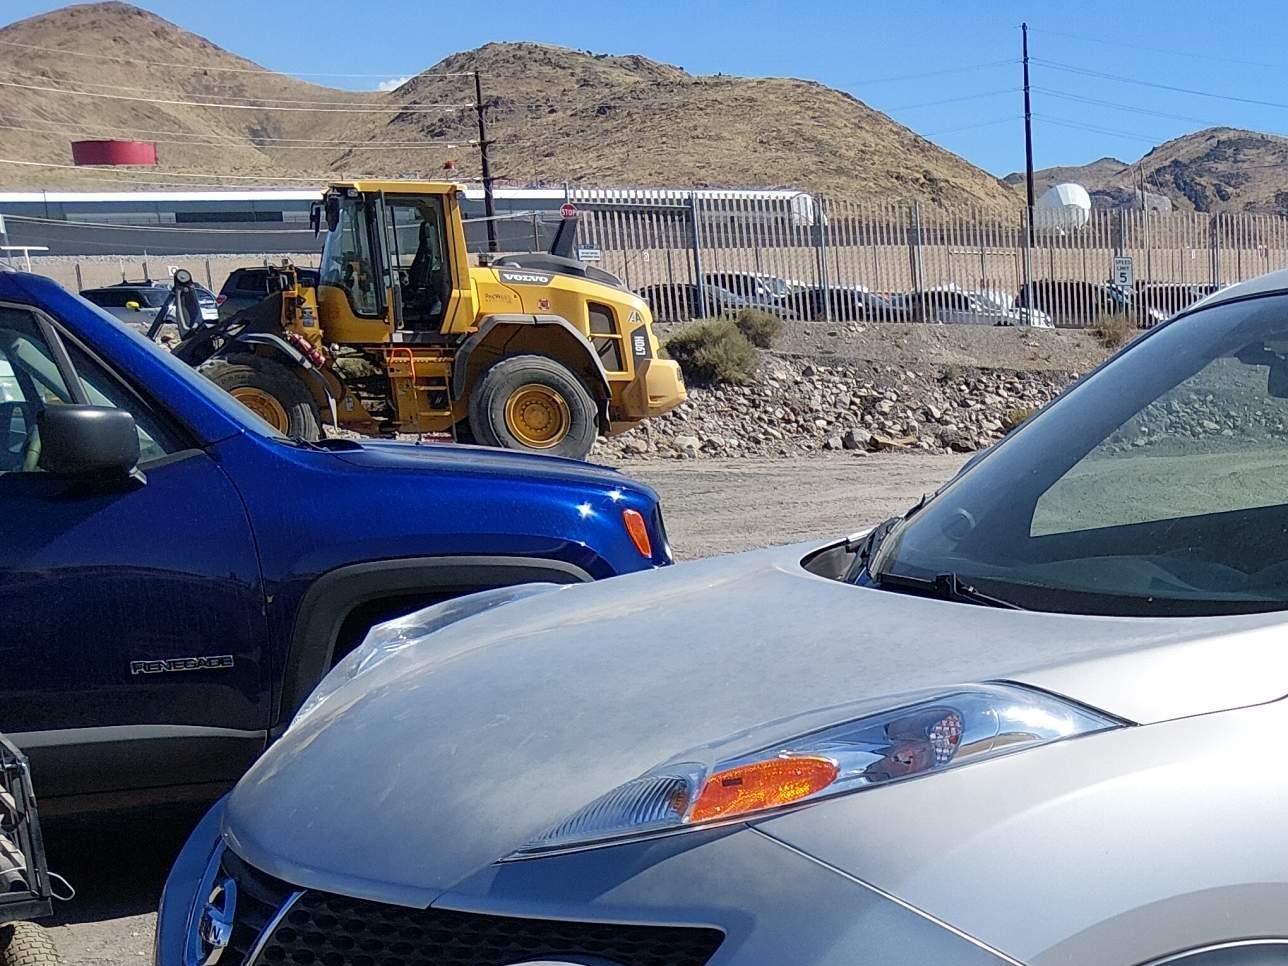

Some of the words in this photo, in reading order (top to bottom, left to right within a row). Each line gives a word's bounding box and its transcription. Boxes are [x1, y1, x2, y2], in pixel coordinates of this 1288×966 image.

[562, 208, 576, 216] STOP
[503, 273, 549, 284] VOLVO
[1119, 272, 1128, 283] 5
[633, 335, 646, 356] L90H
[130, 655, 234, 675] RENEGADE
